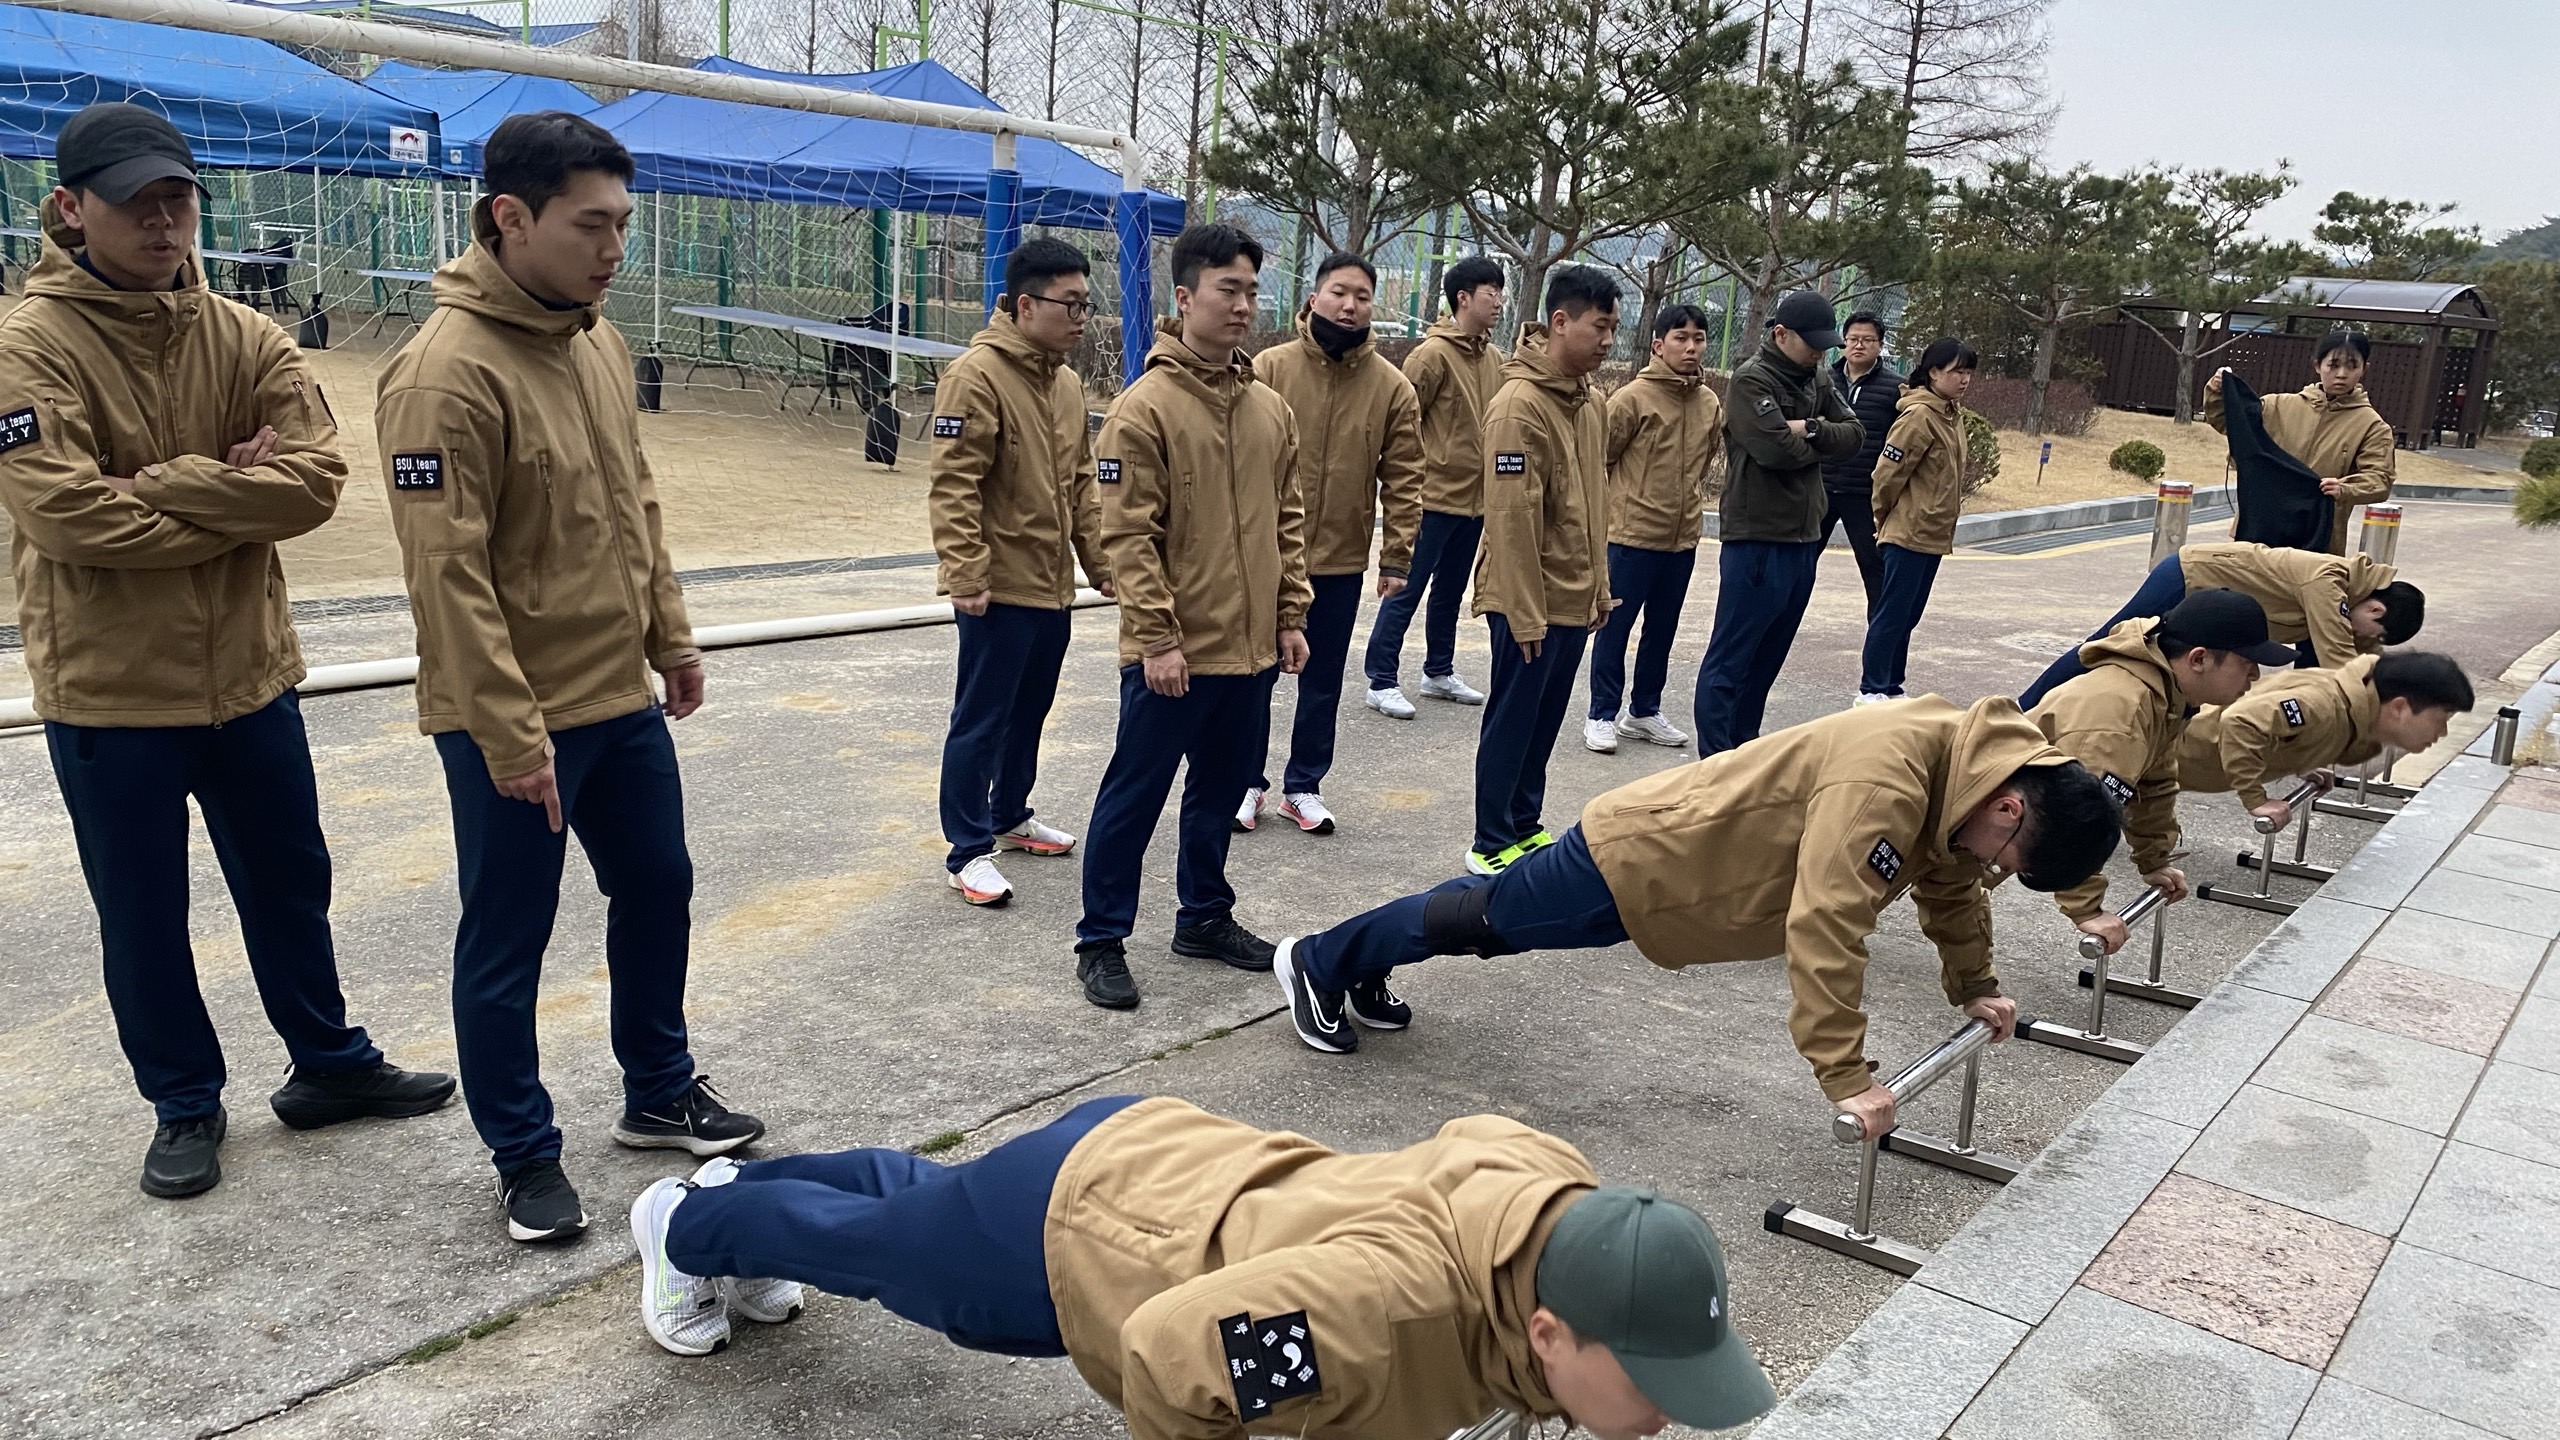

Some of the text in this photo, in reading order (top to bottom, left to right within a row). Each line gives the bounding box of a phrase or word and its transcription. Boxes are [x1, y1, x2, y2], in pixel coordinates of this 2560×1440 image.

[0, 413, 33, 432] U. team
[395, 456, 438, 471] BSU. team
